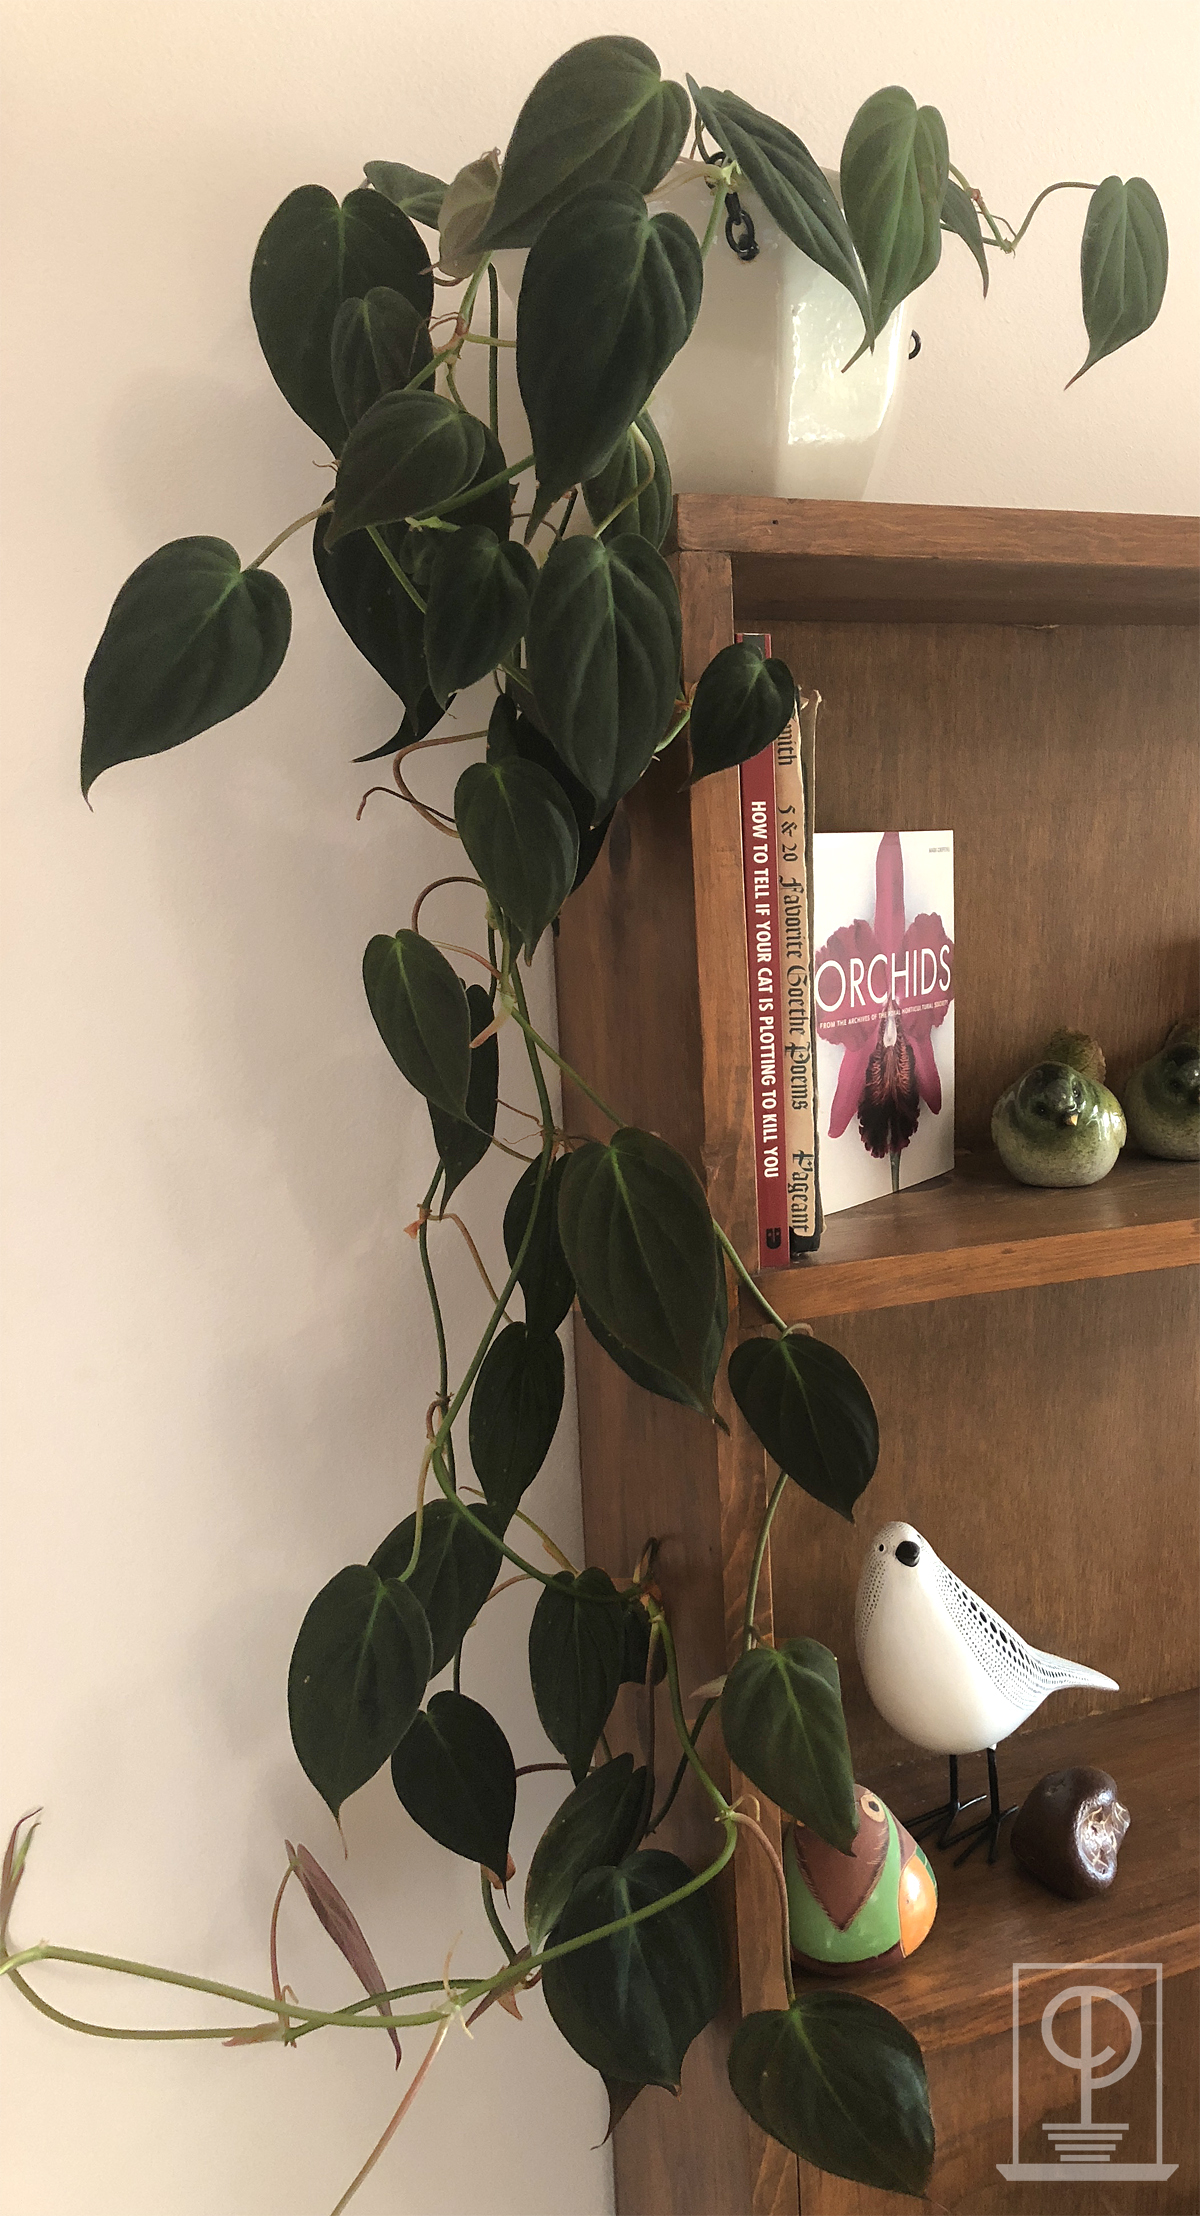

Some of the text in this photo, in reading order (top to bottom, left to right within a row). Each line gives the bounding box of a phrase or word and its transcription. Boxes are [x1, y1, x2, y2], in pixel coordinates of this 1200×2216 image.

[777, 724, 797, 765] mith
[781, 821, 797, 837] &
[782, 843, 798, 861] 20
[779, 875, 804, 959] Favorite
[752, 801, 779, 1178] HOW TO TELL IF YOUR CAT IS PLOTTING TO KILL YOU
[786, 965, 808, 1035] Goethe
[814, 945, 951, 1012] ORCHIDS
[820, 1021, 836, 1029] FROM
[837, 1018, 847, 1026] THE
[848, 1015, 870, 1025] ARCHIVES
[785, 1042, 810, 1110] Poems
[788, 1150, 814, 1232] Pageant
